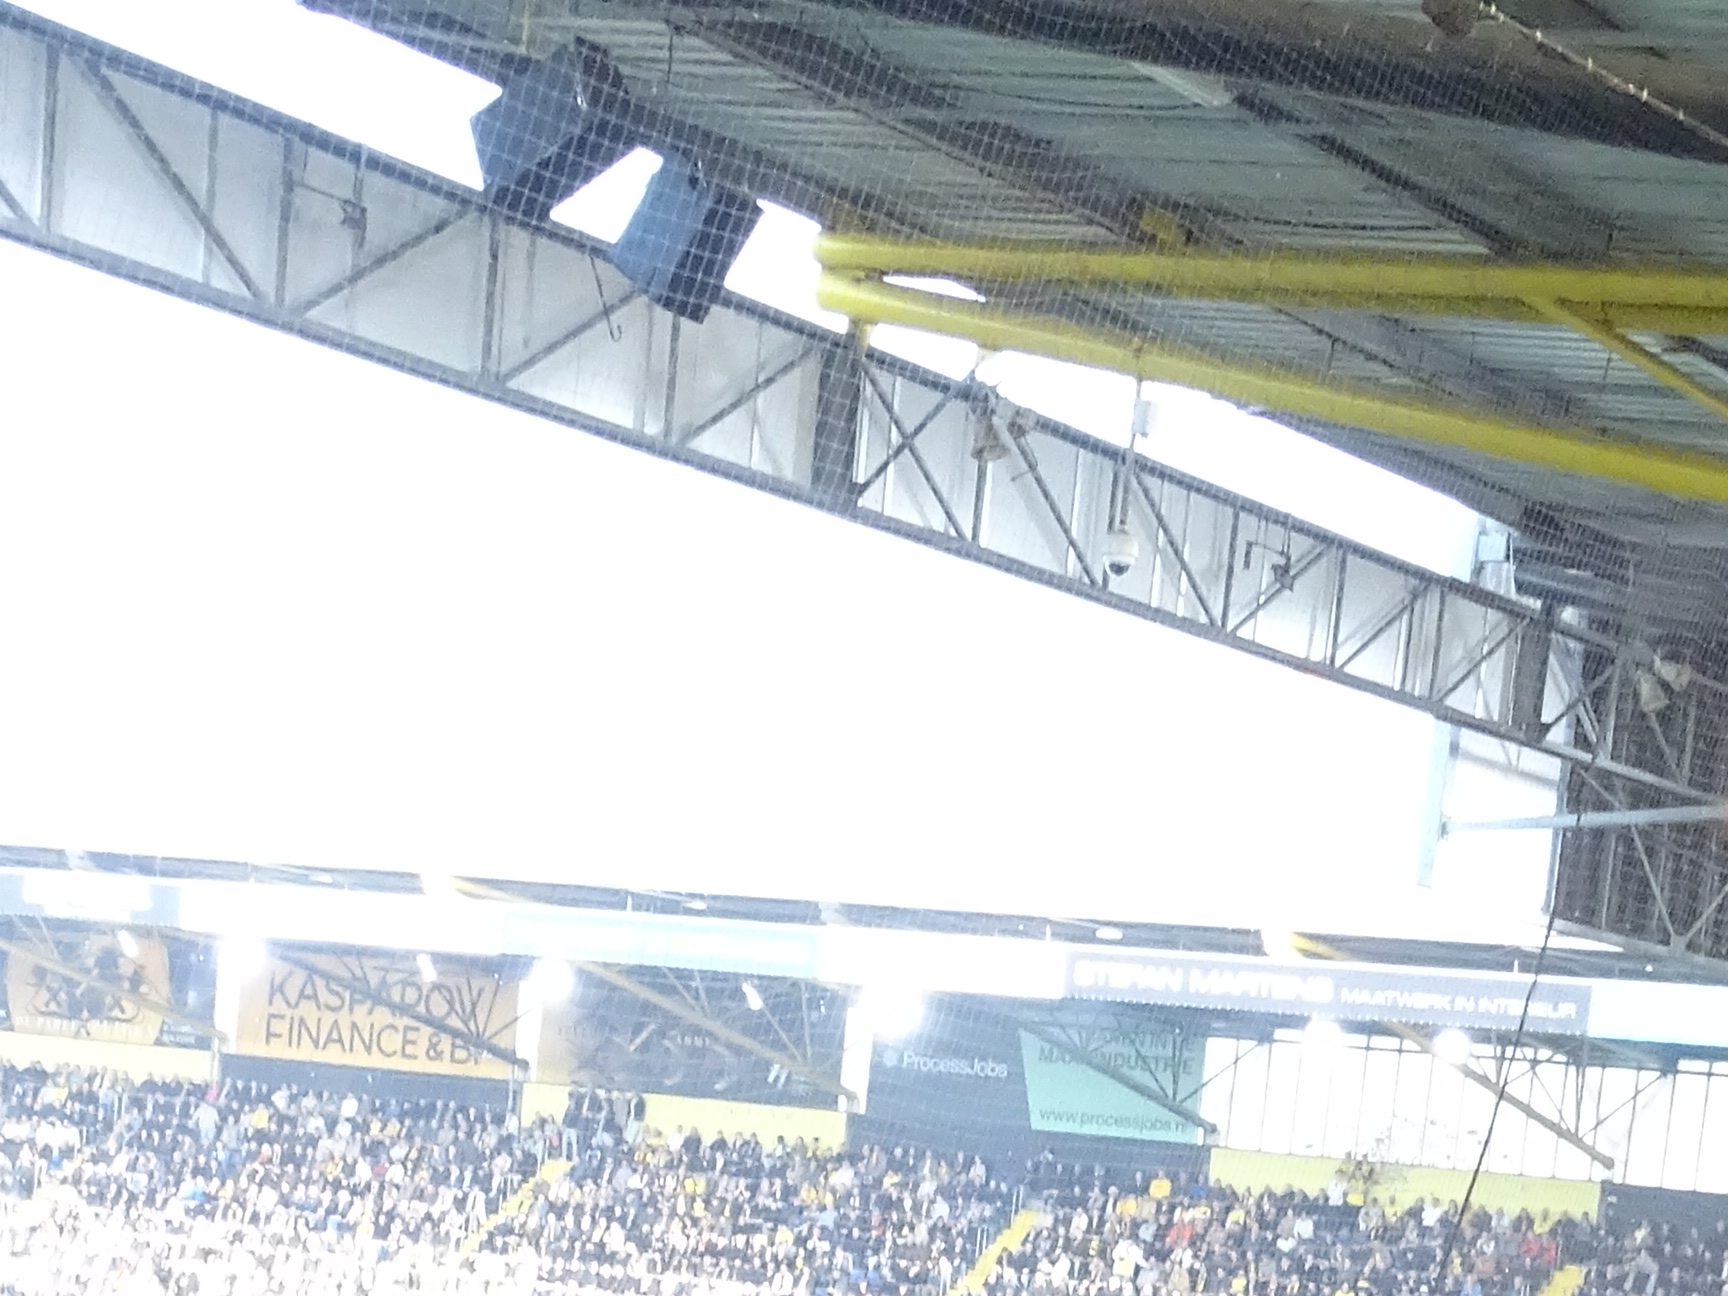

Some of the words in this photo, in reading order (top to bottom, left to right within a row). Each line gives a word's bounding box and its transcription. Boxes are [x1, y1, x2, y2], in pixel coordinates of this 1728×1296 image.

[1450, 996, 1474, 1014] IN
[265, 1012, 420, 1060] FINANCE
[425, 1032, 445, 1062] &
[902, 1052, 1008, 1077] ProcessJobs
